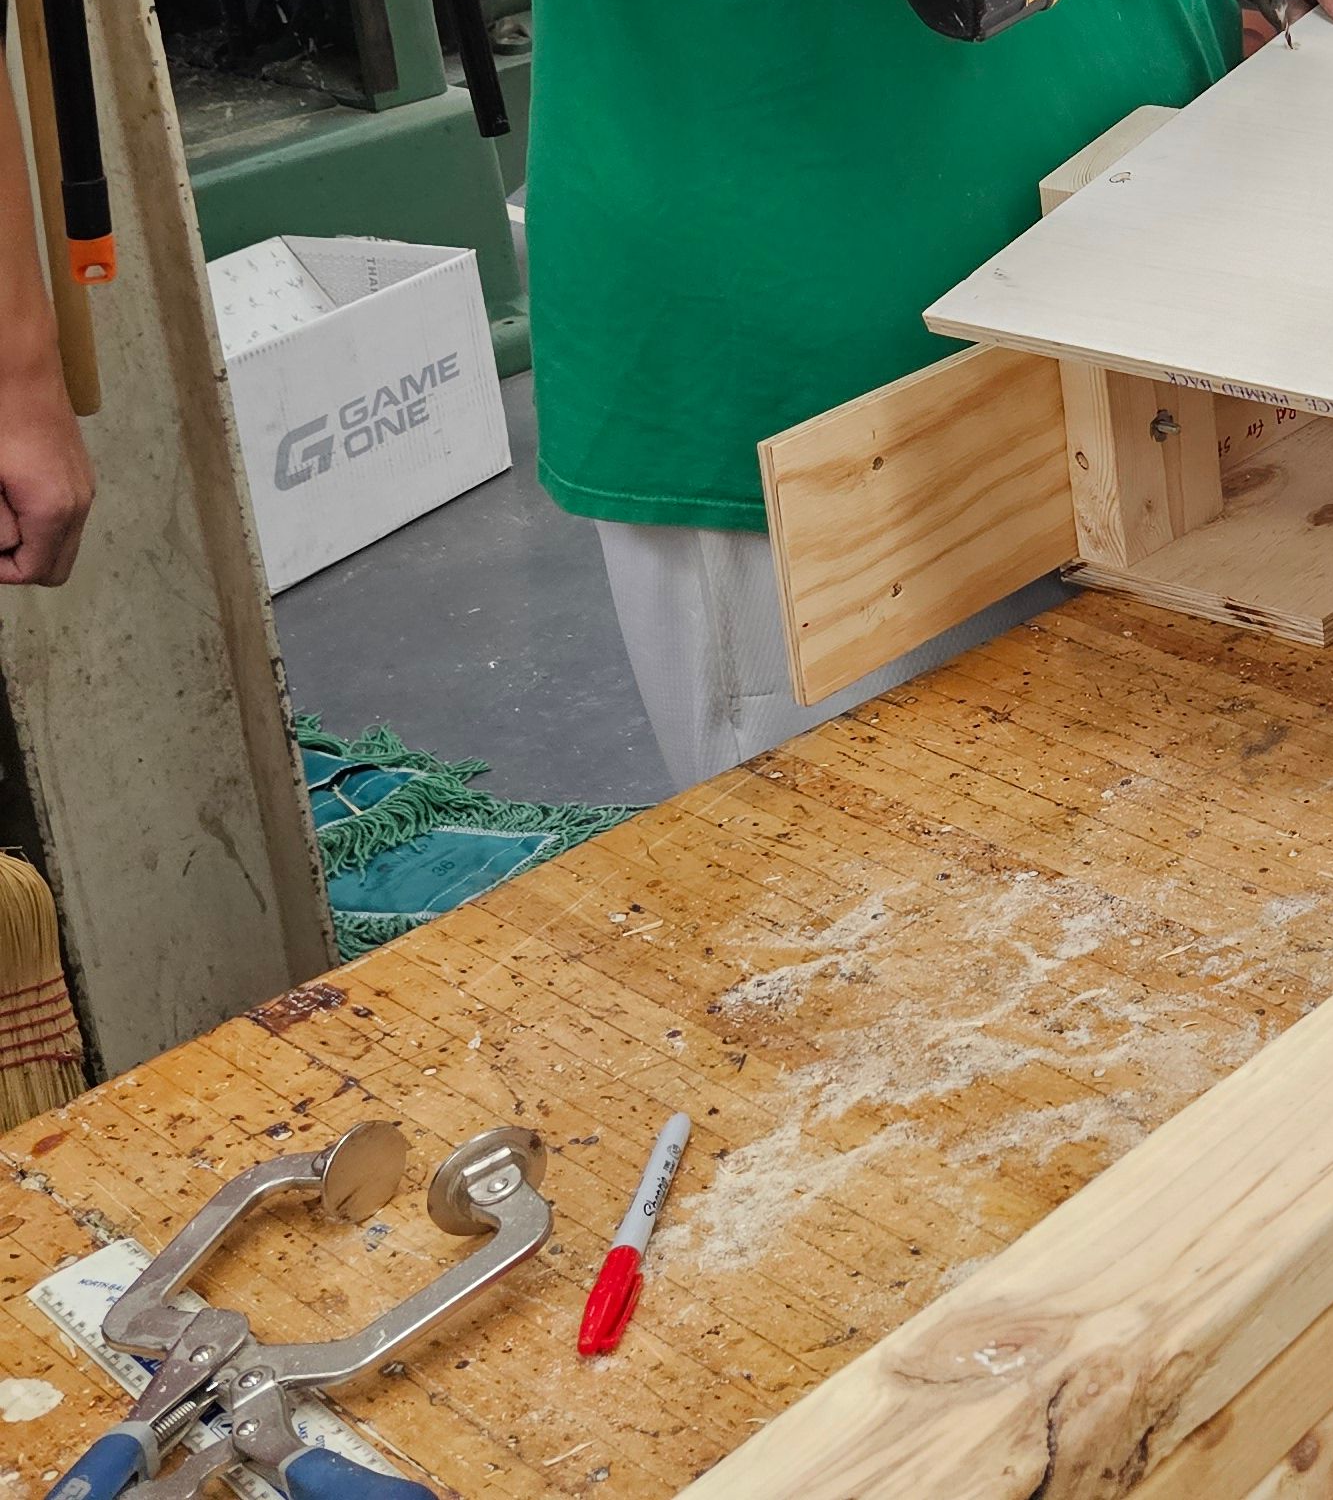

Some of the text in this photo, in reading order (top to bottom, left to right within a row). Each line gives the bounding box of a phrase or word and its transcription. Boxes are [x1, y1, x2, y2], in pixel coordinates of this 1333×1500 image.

[338, 351, 460, 431] GAME
[1163, 371, 1212, 393] BACK
[1221, 383, 1289, 405] PRIMED
[343, 396, 430, 458] ONE
[432, 859, 456, 877] 36
